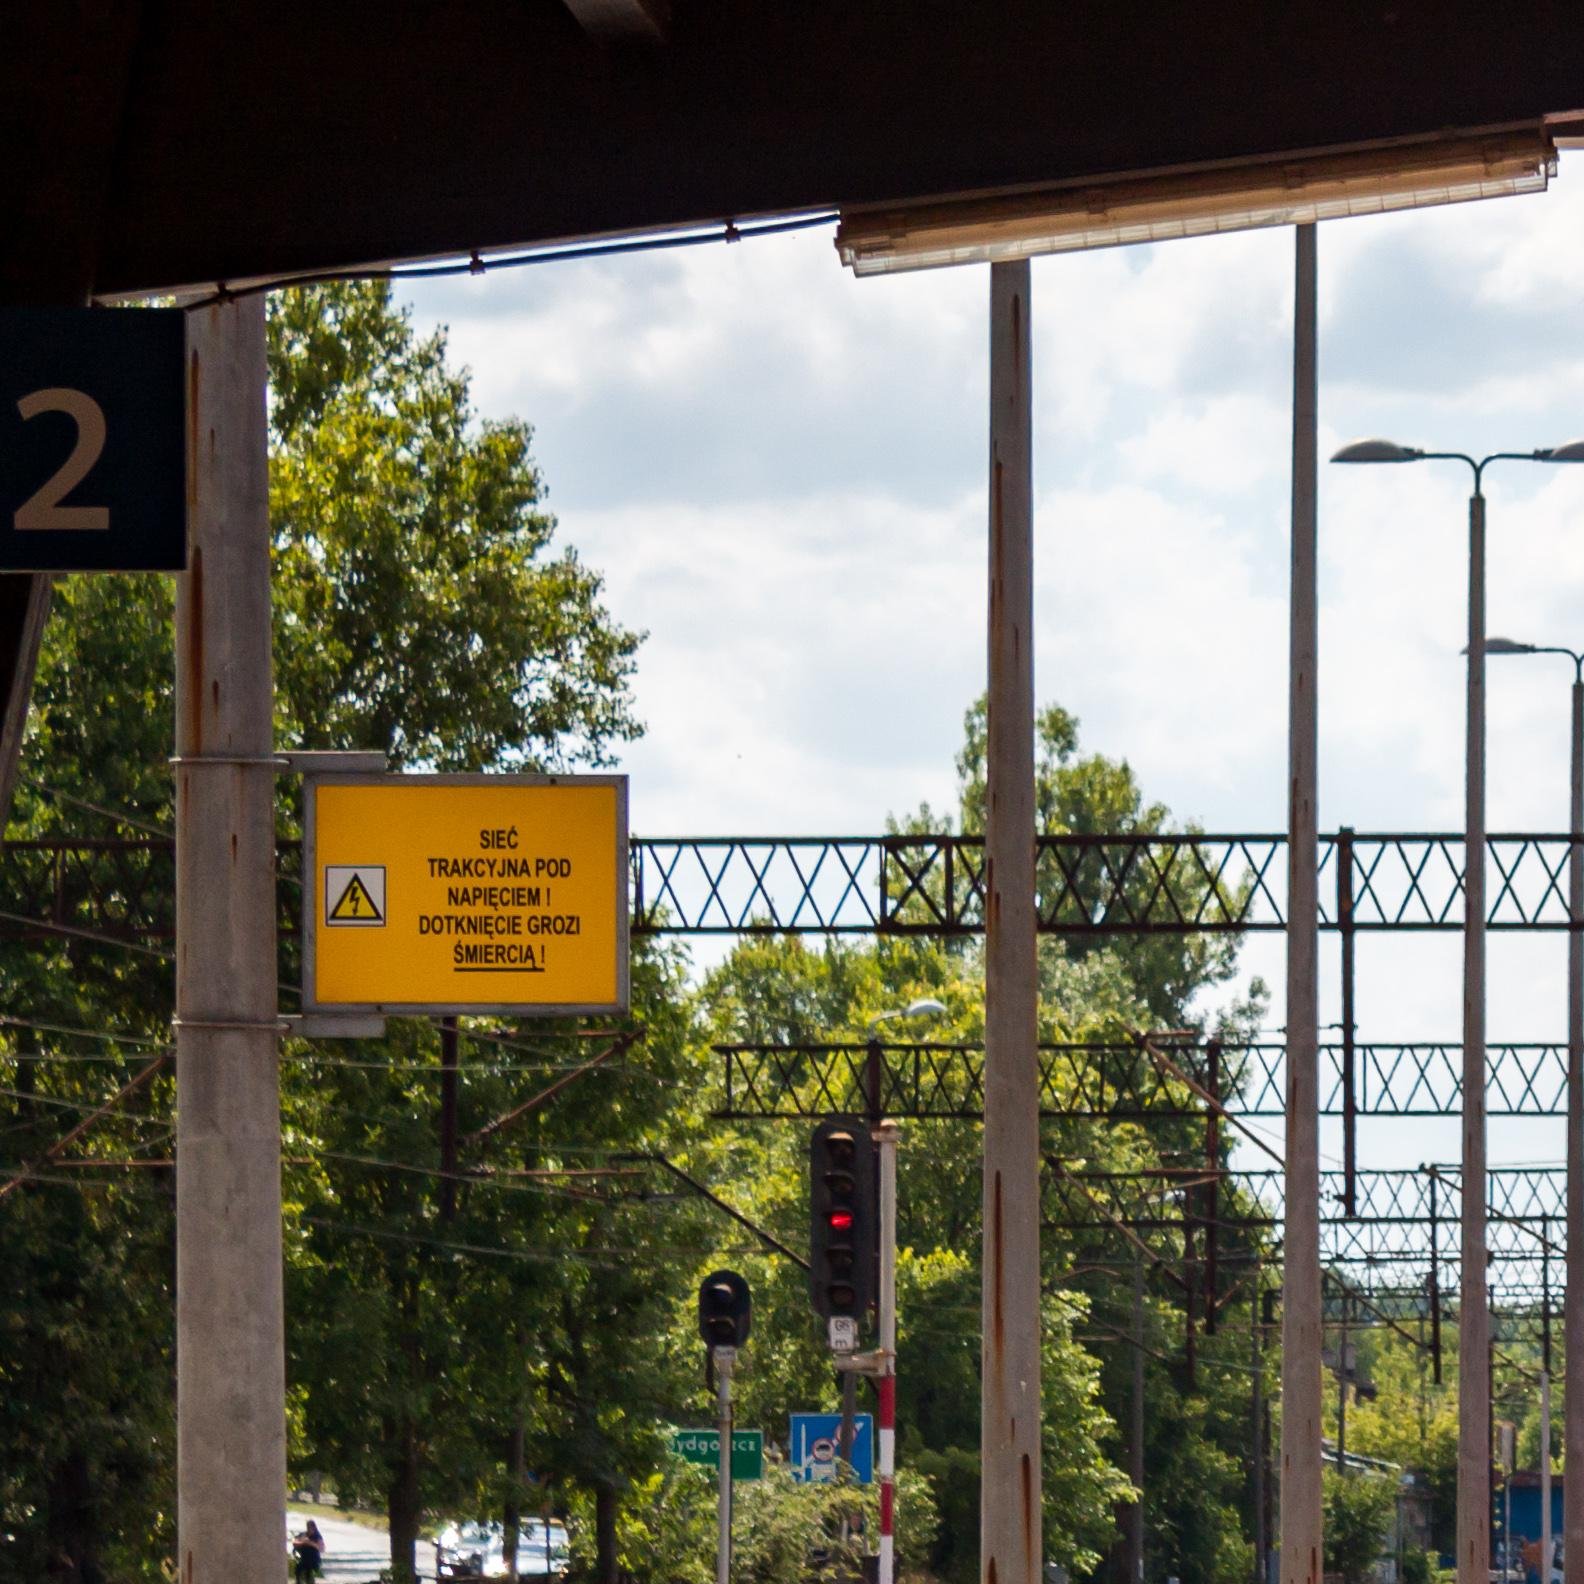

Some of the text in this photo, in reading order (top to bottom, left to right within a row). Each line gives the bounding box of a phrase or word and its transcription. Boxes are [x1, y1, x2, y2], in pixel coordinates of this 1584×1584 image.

[14, 388, 109, 530] 2
[480, 826, 518, 849] SIEĆ
[428, 858, 571, 877] TRAKCYJNA POD
[448, 887, 540, 911] NAPIĘCIEM
[419, 915, 580, 939] DOTKNIĘCIE GROZI
[454, 940, 537, 968] ŚMIERCIĄ
[671, 1435, 756, 1455] ydgocz
